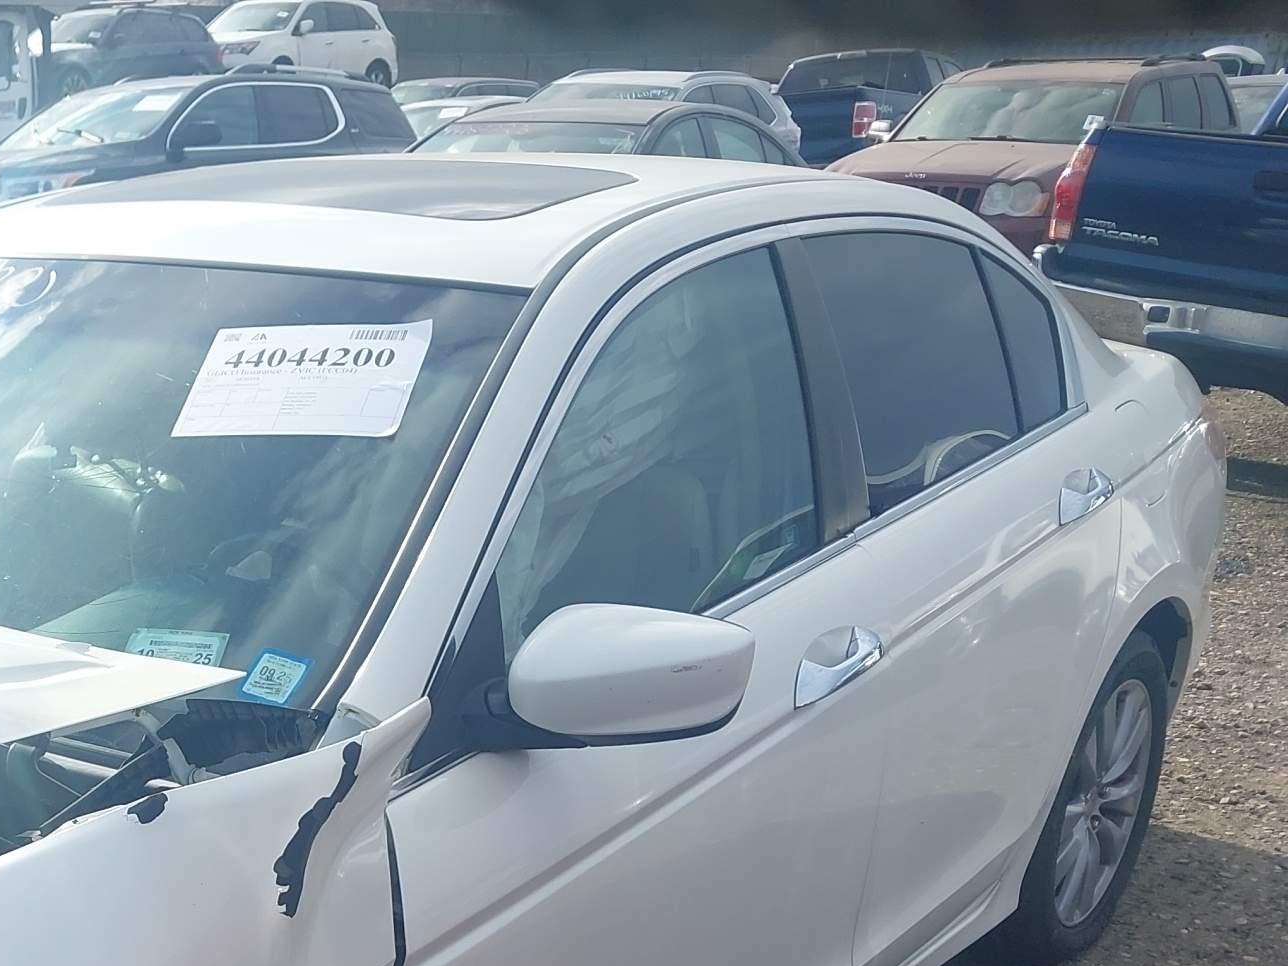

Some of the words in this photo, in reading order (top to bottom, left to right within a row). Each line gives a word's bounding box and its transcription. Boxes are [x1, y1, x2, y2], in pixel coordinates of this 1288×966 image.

[1083, 217, 1116, 229] TOYOTA
[1081, 226, 1159, 246] TACOMA
[224, 347, 396, 368] 44044200
[192, 653, 213, 665] 25
